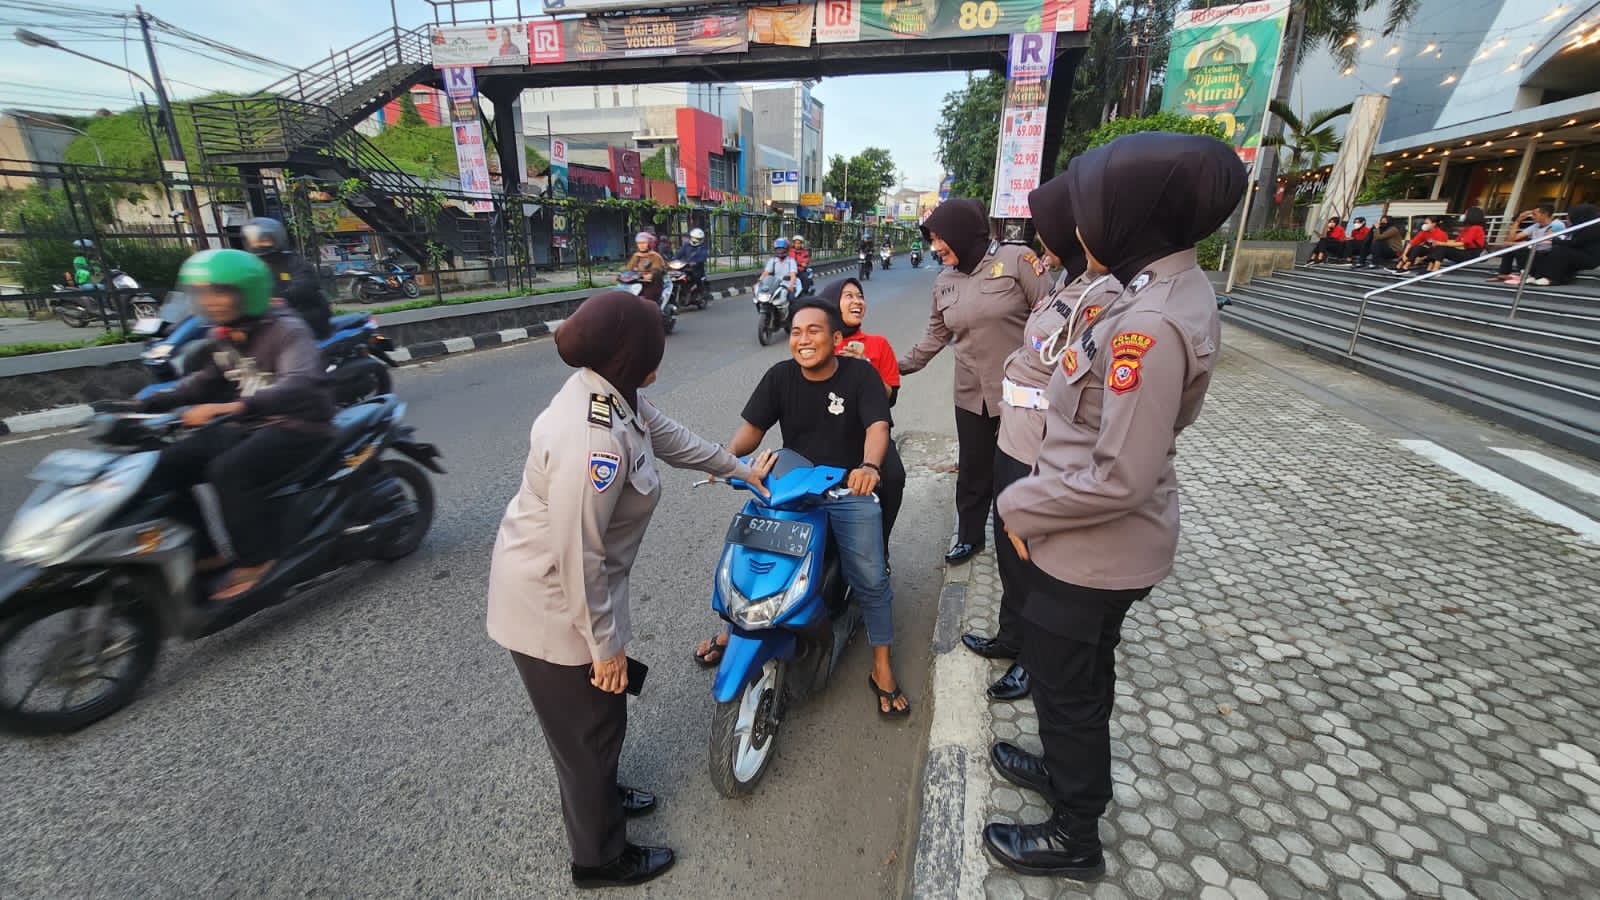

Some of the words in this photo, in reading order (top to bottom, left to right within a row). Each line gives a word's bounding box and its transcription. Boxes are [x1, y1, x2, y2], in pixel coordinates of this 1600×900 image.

[958, 1, 999, 30] 80
[1207, 5, 1271, 18] Ramayana
[624, 22, 677, 37] BAGI-BAGI
[625, 35, 676, 48] VOUCHER
[1020, 34, 1044, 63] R
[1016, 125, 1042, 137] 69.000
[1010, 179, 1036, 190] 155.000
[733, 514, 742, 528] T
[748, 517, 781, 534] 6277
